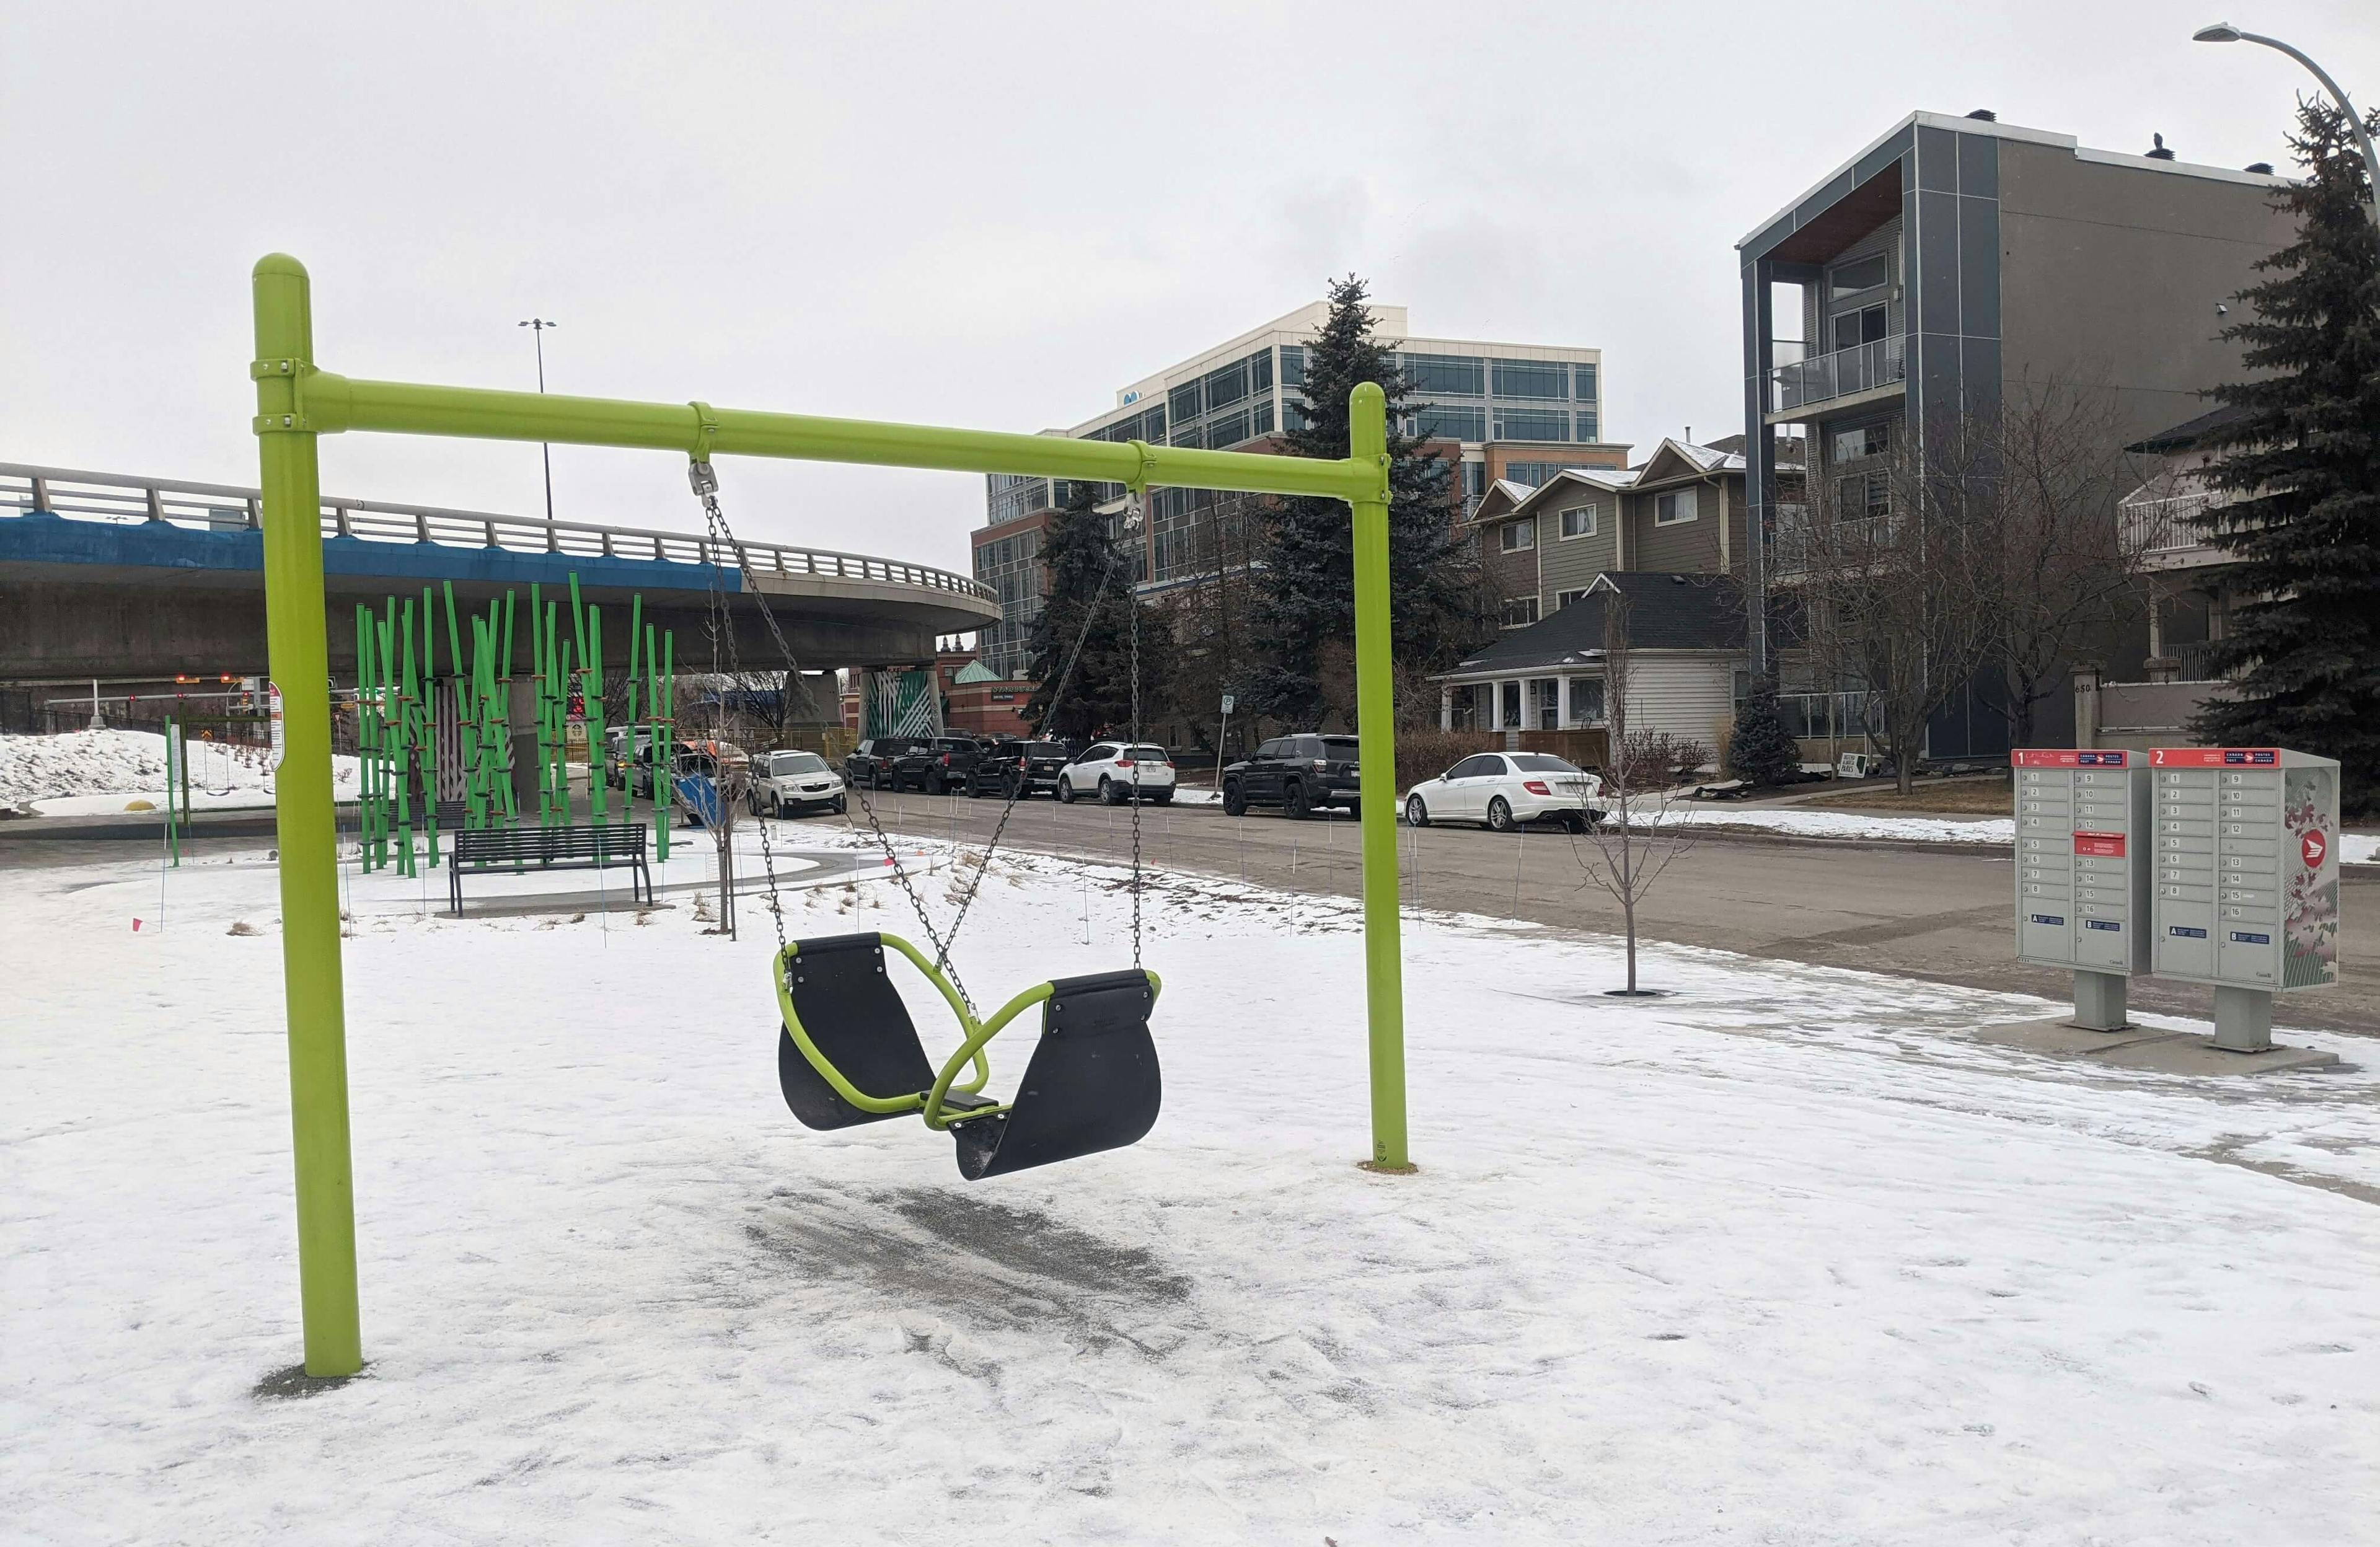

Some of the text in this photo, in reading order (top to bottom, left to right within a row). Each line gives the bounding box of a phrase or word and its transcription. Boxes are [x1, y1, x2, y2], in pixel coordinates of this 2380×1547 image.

[2075, 684, 2090, 693] 650
[2018, 752, 2024, 764] 1
[2156, 751, 2163, 764] 2
